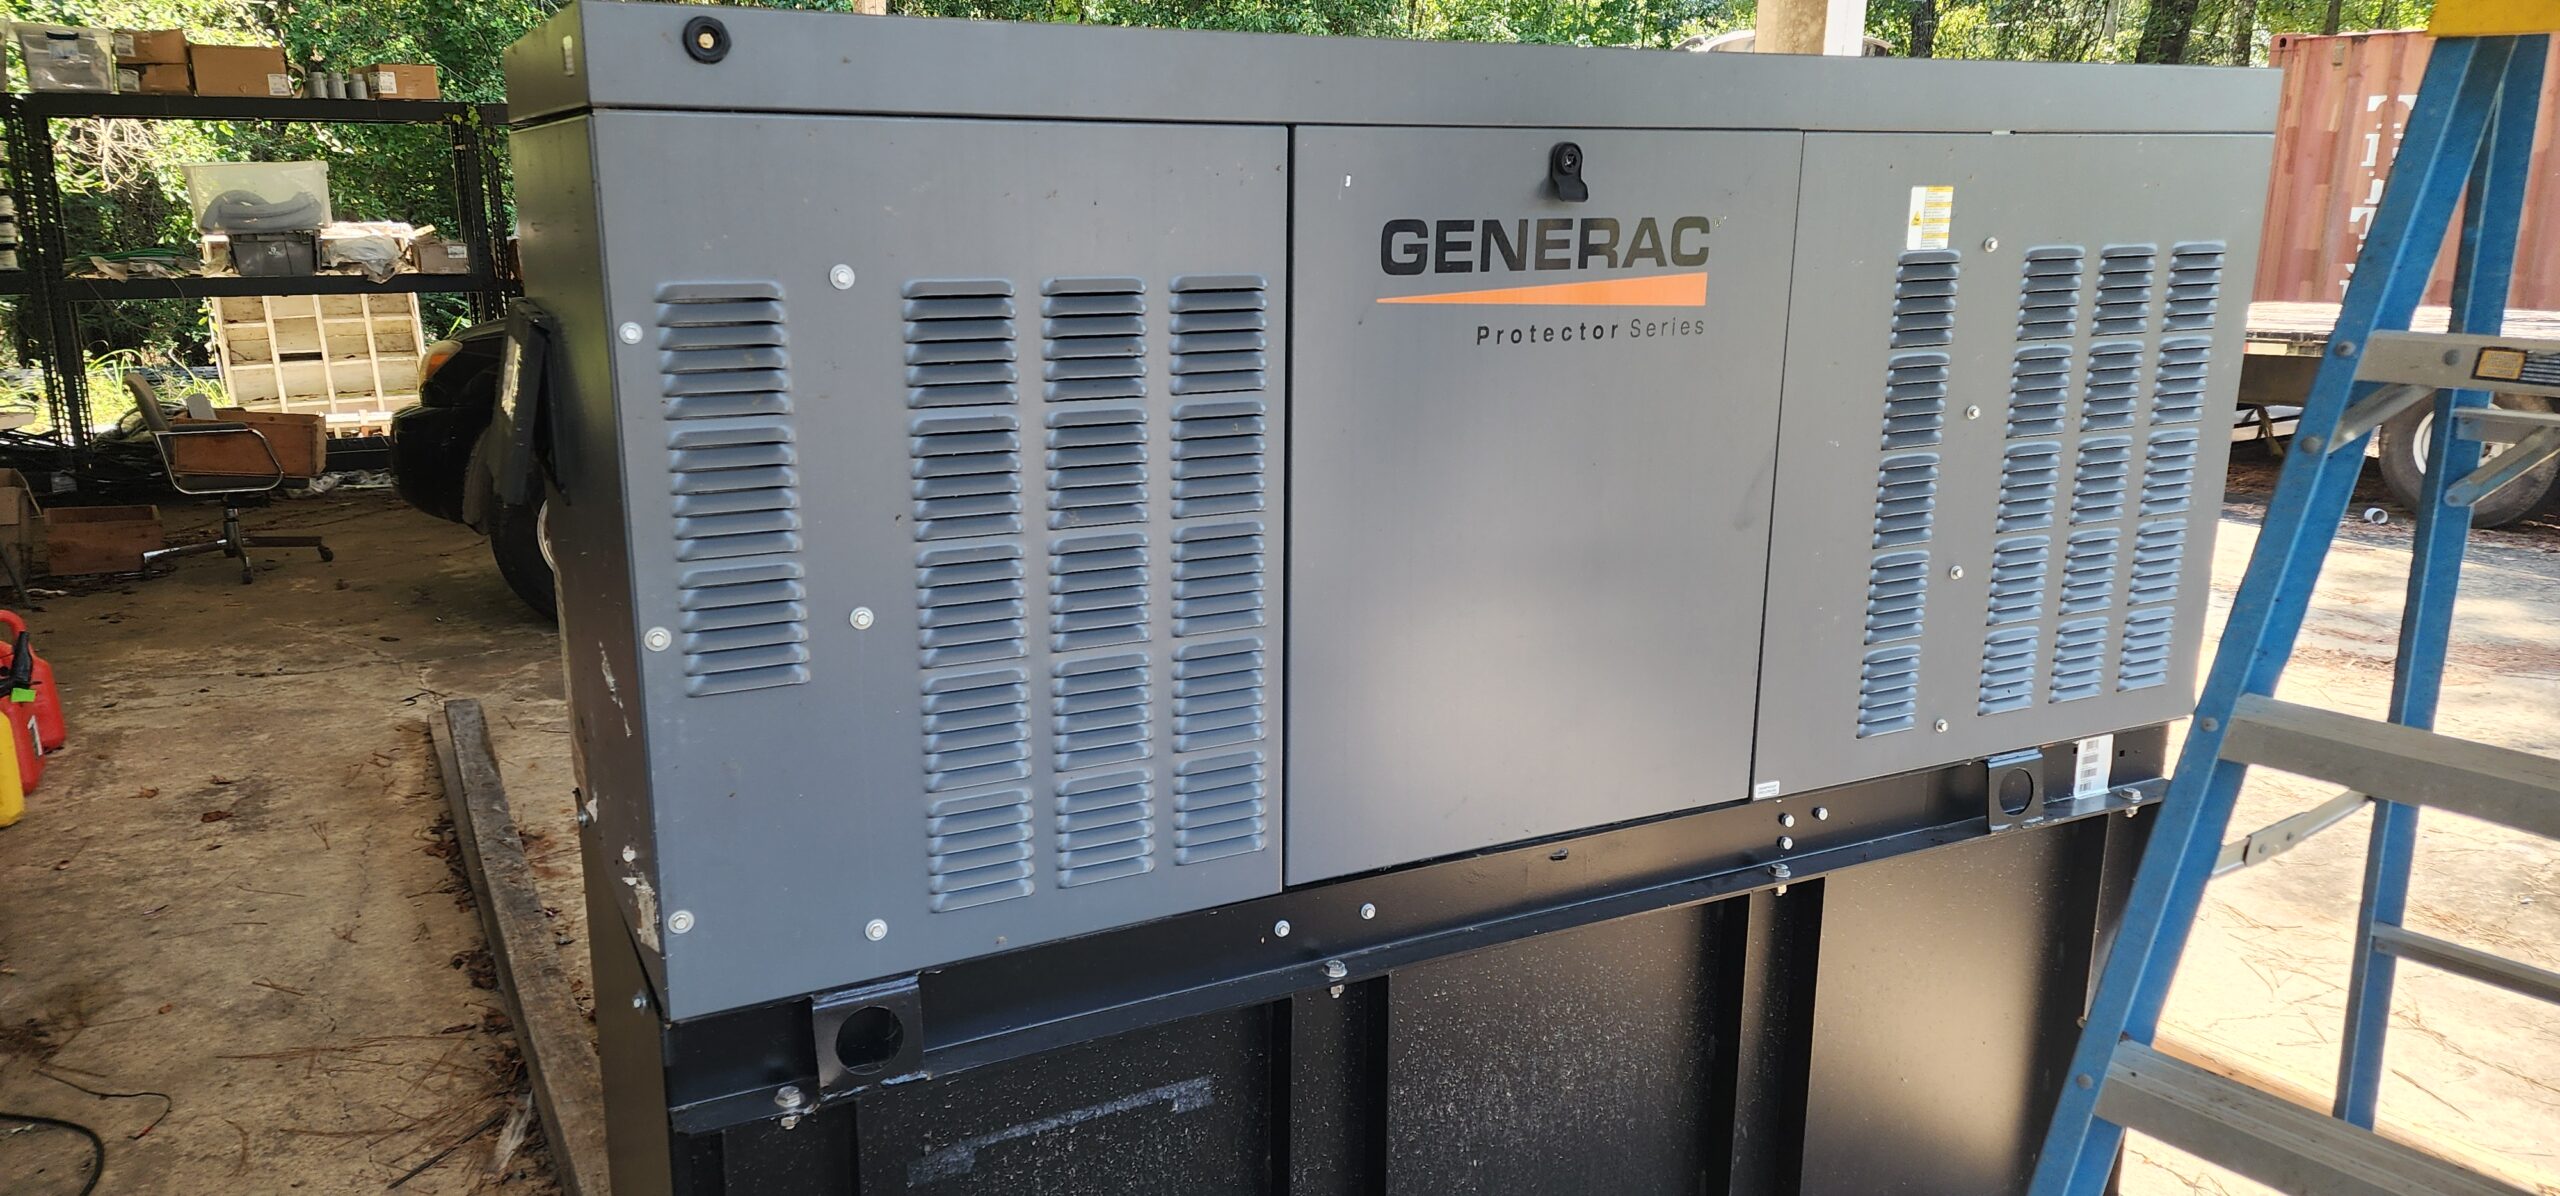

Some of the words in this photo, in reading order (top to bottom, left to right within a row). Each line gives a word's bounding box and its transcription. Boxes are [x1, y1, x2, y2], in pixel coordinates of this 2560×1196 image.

[1380, 216, 1711, 276] GENERAC
[1476, 322, 1619, 345] Protector
[1629, 317, 1705, 338] Series
